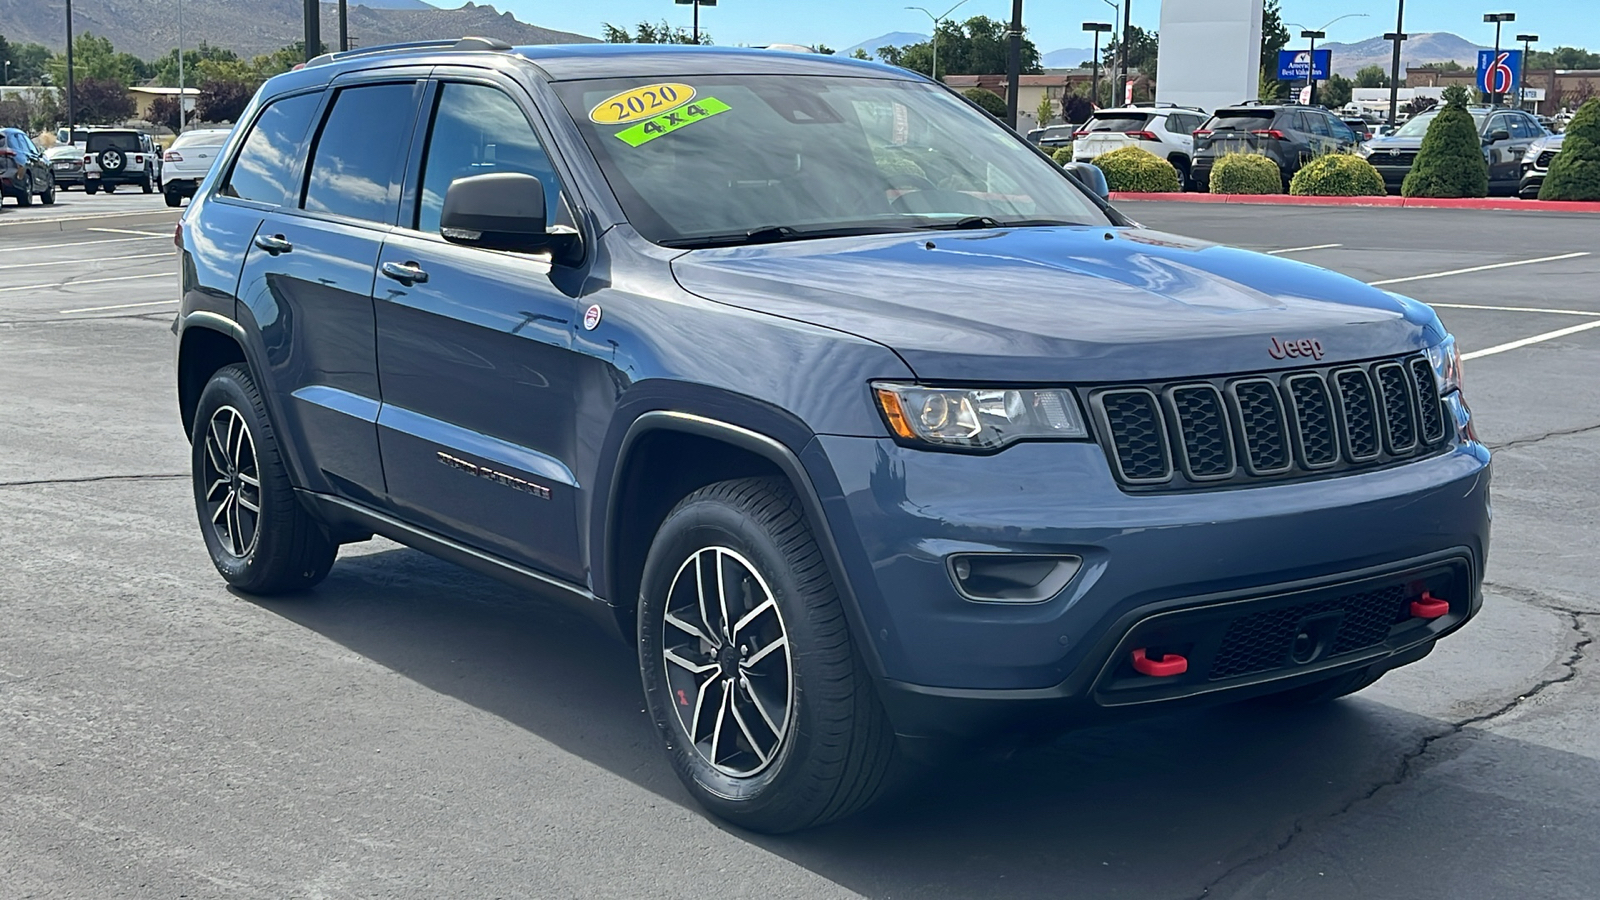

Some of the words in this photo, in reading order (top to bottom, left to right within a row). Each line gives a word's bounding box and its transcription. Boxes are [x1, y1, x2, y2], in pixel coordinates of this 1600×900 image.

[1484, 52, 1513, 94] 6
[609, 86, 678, 121] 2020
[1268, 336, 1325, 361] Jeep
